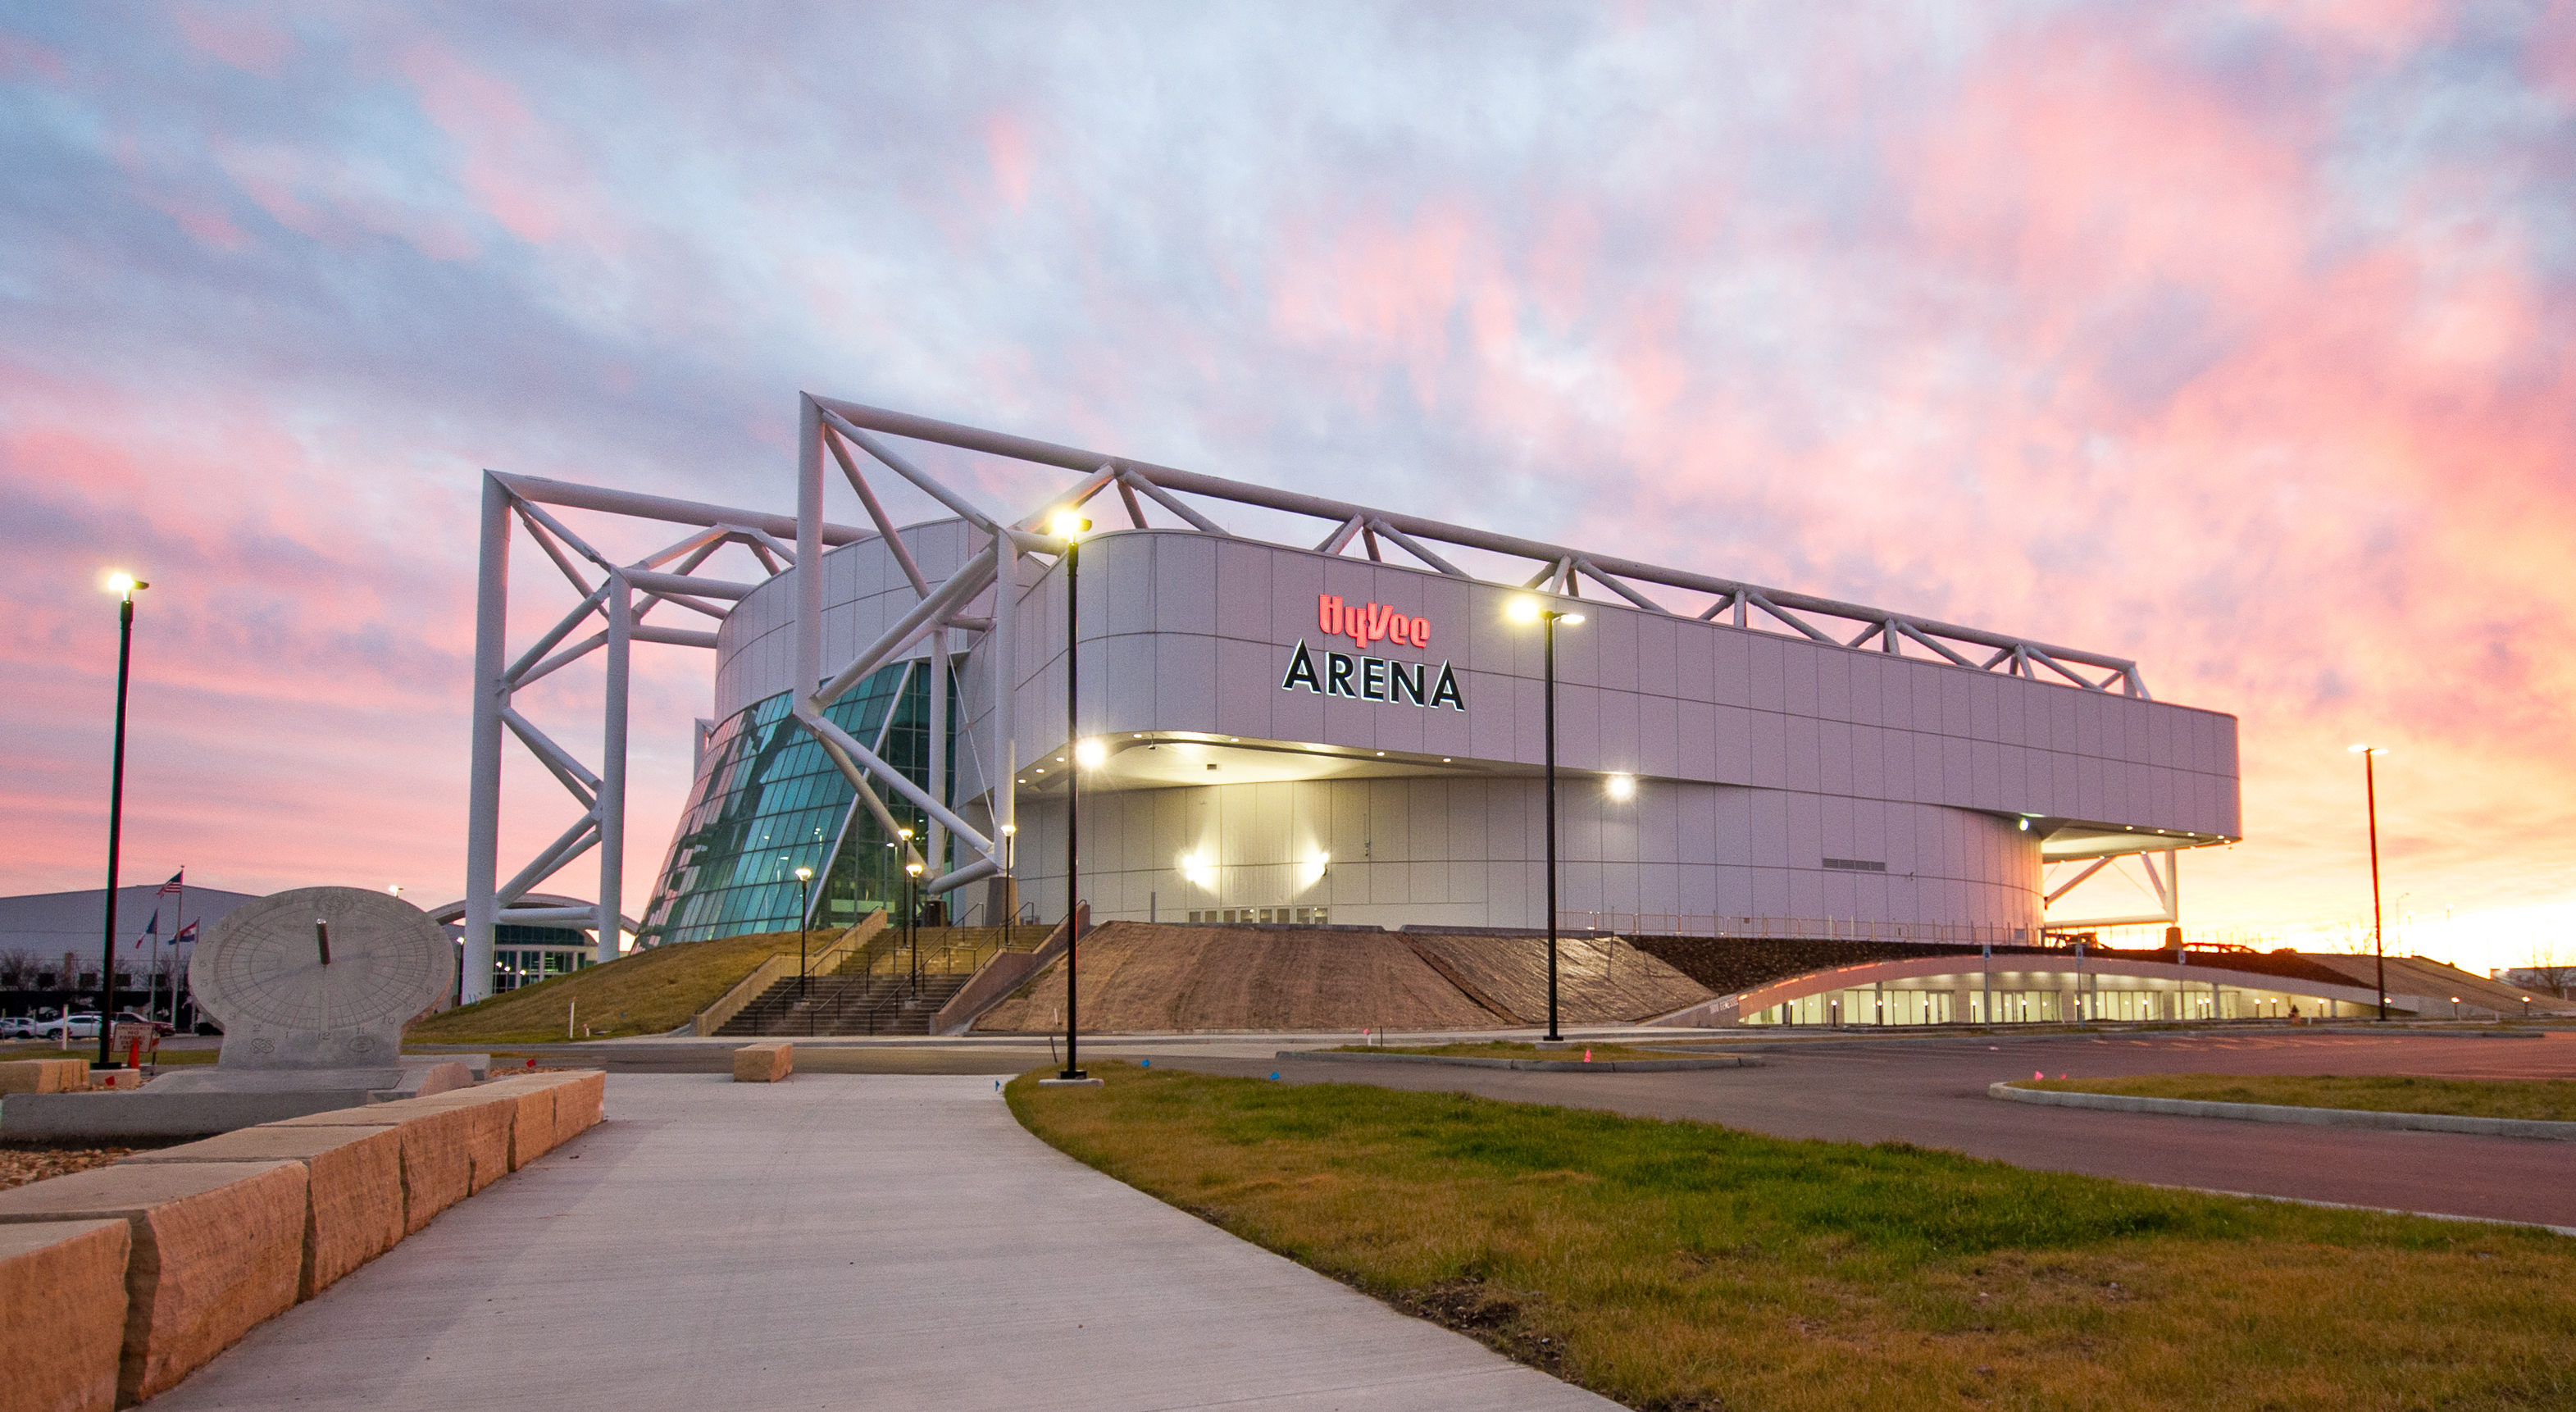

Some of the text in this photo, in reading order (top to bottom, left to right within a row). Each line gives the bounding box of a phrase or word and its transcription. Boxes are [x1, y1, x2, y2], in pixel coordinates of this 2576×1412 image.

[1281, 638, 1465, 712] ARENA
[383, 1015, 397, 1025] 10
[253, 1023, 262, 1032] 2
[356, 1027, 365, 1035] 11
[317, 1032, 331, 1041] 12
